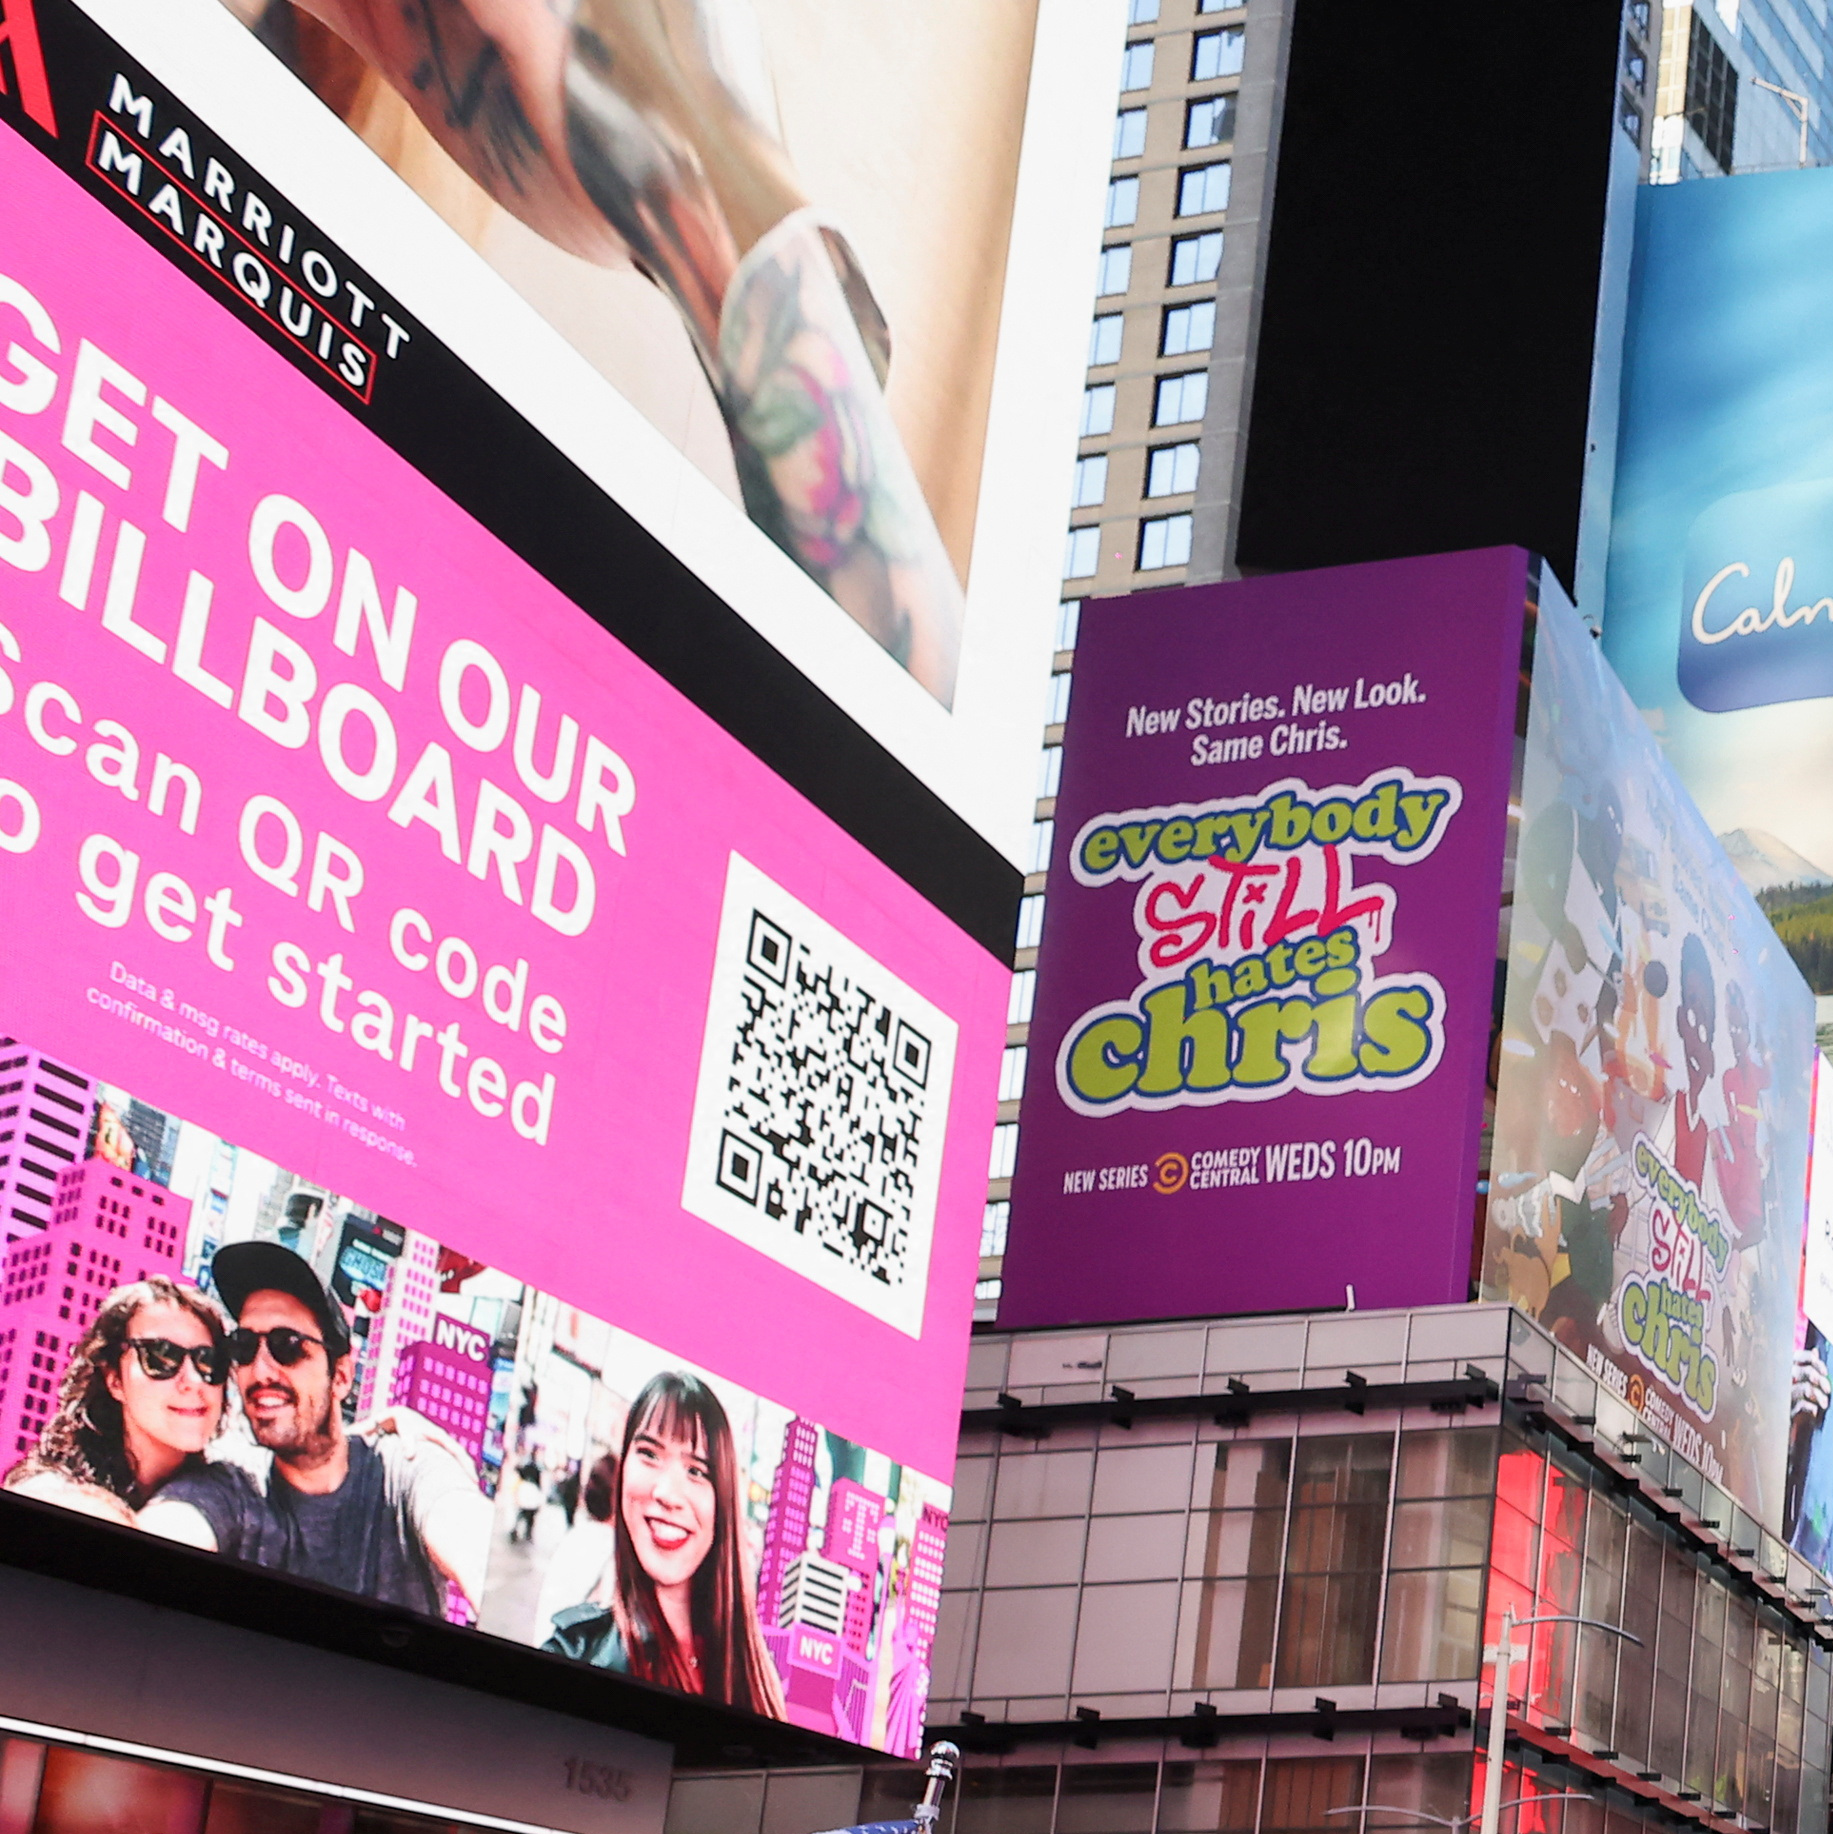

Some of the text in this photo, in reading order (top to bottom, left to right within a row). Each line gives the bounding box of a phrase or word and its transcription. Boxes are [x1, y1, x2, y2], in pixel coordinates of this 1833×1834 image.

[110, 73, 409, 358] MARRIOTT
[96, 132, 370, 389] MARQUIS
[0, 272, 636, 857] GET ON OUR
[0, 431, 597, 937] BILLBOARD
[1126, 672, 1427, 738] New Stories. New Look.
[1190, 720, 1348, 767] Same Chris.
[1081, 779, 1451, 874] everybody
[0, 778, 556, 1146] o get started
[239, 794, 365, 933] QR
[389, 907, 568, 1054] code
[1186, 926, 1358, 1011] hates
[86, 985, 419, 1168] confirmation & terms sent in response.
[110, 960, 406, 1132] Data & msg rates apply. Texts with
[1066, 966, 1434, 1104] chris
[1063, 1164, 1149, 1195] NEW SERIES
[1189, 1166, 1260, 1191] CENTRAL
[1190, 1146, 1262, 1170] COMEDY
[1264, 1137, 1402, 1183] WEDS 10PM
[1635, 1140, 1730, 1274] everybody
[435, 1318, 488, 1362] NYC
[1586, 1343, 1629, 1399] NEW SERIES
[1621, 1281, 1717, 1416] chris
[1642, 1407, 1672, 1439] CENTRAL
[1644, 1384, 1676, 1425] COMEDY
[1672, 1413, 1702, 1464] WEDS
[800, 1636, 834, 1665] NYC
